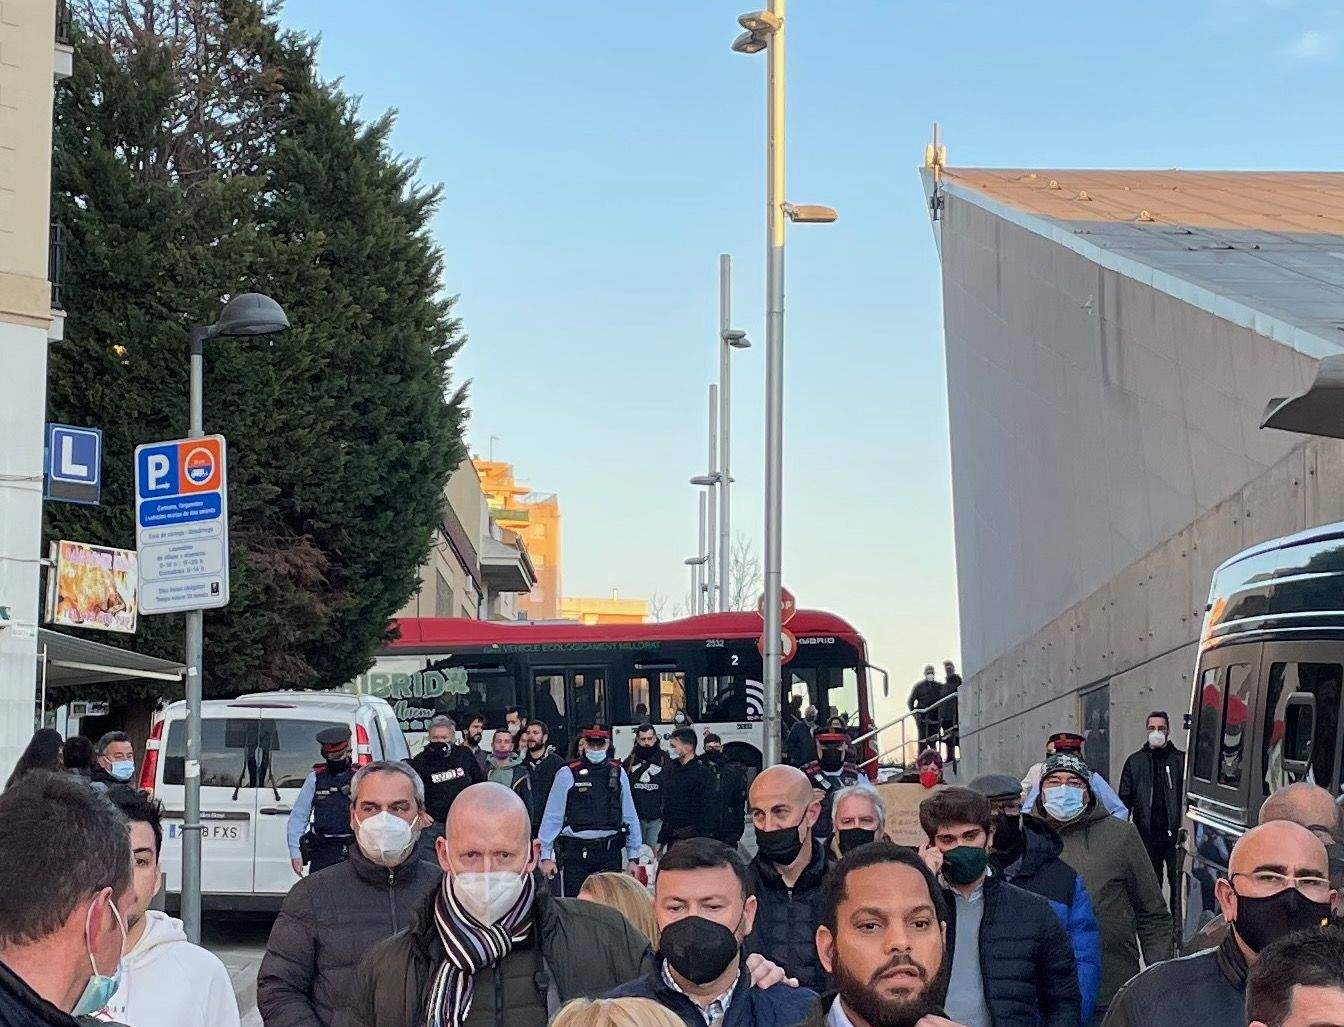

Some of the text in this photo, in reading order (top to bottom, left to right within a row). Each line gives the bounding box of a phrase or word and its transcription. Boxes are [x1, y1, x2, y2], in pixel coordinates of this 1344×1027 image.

[62, 436, 88, 477] L
[147, 454, 170, 490] P
[731, 655, 739, 666] 2
[213, 826, 238, 839] FXS
